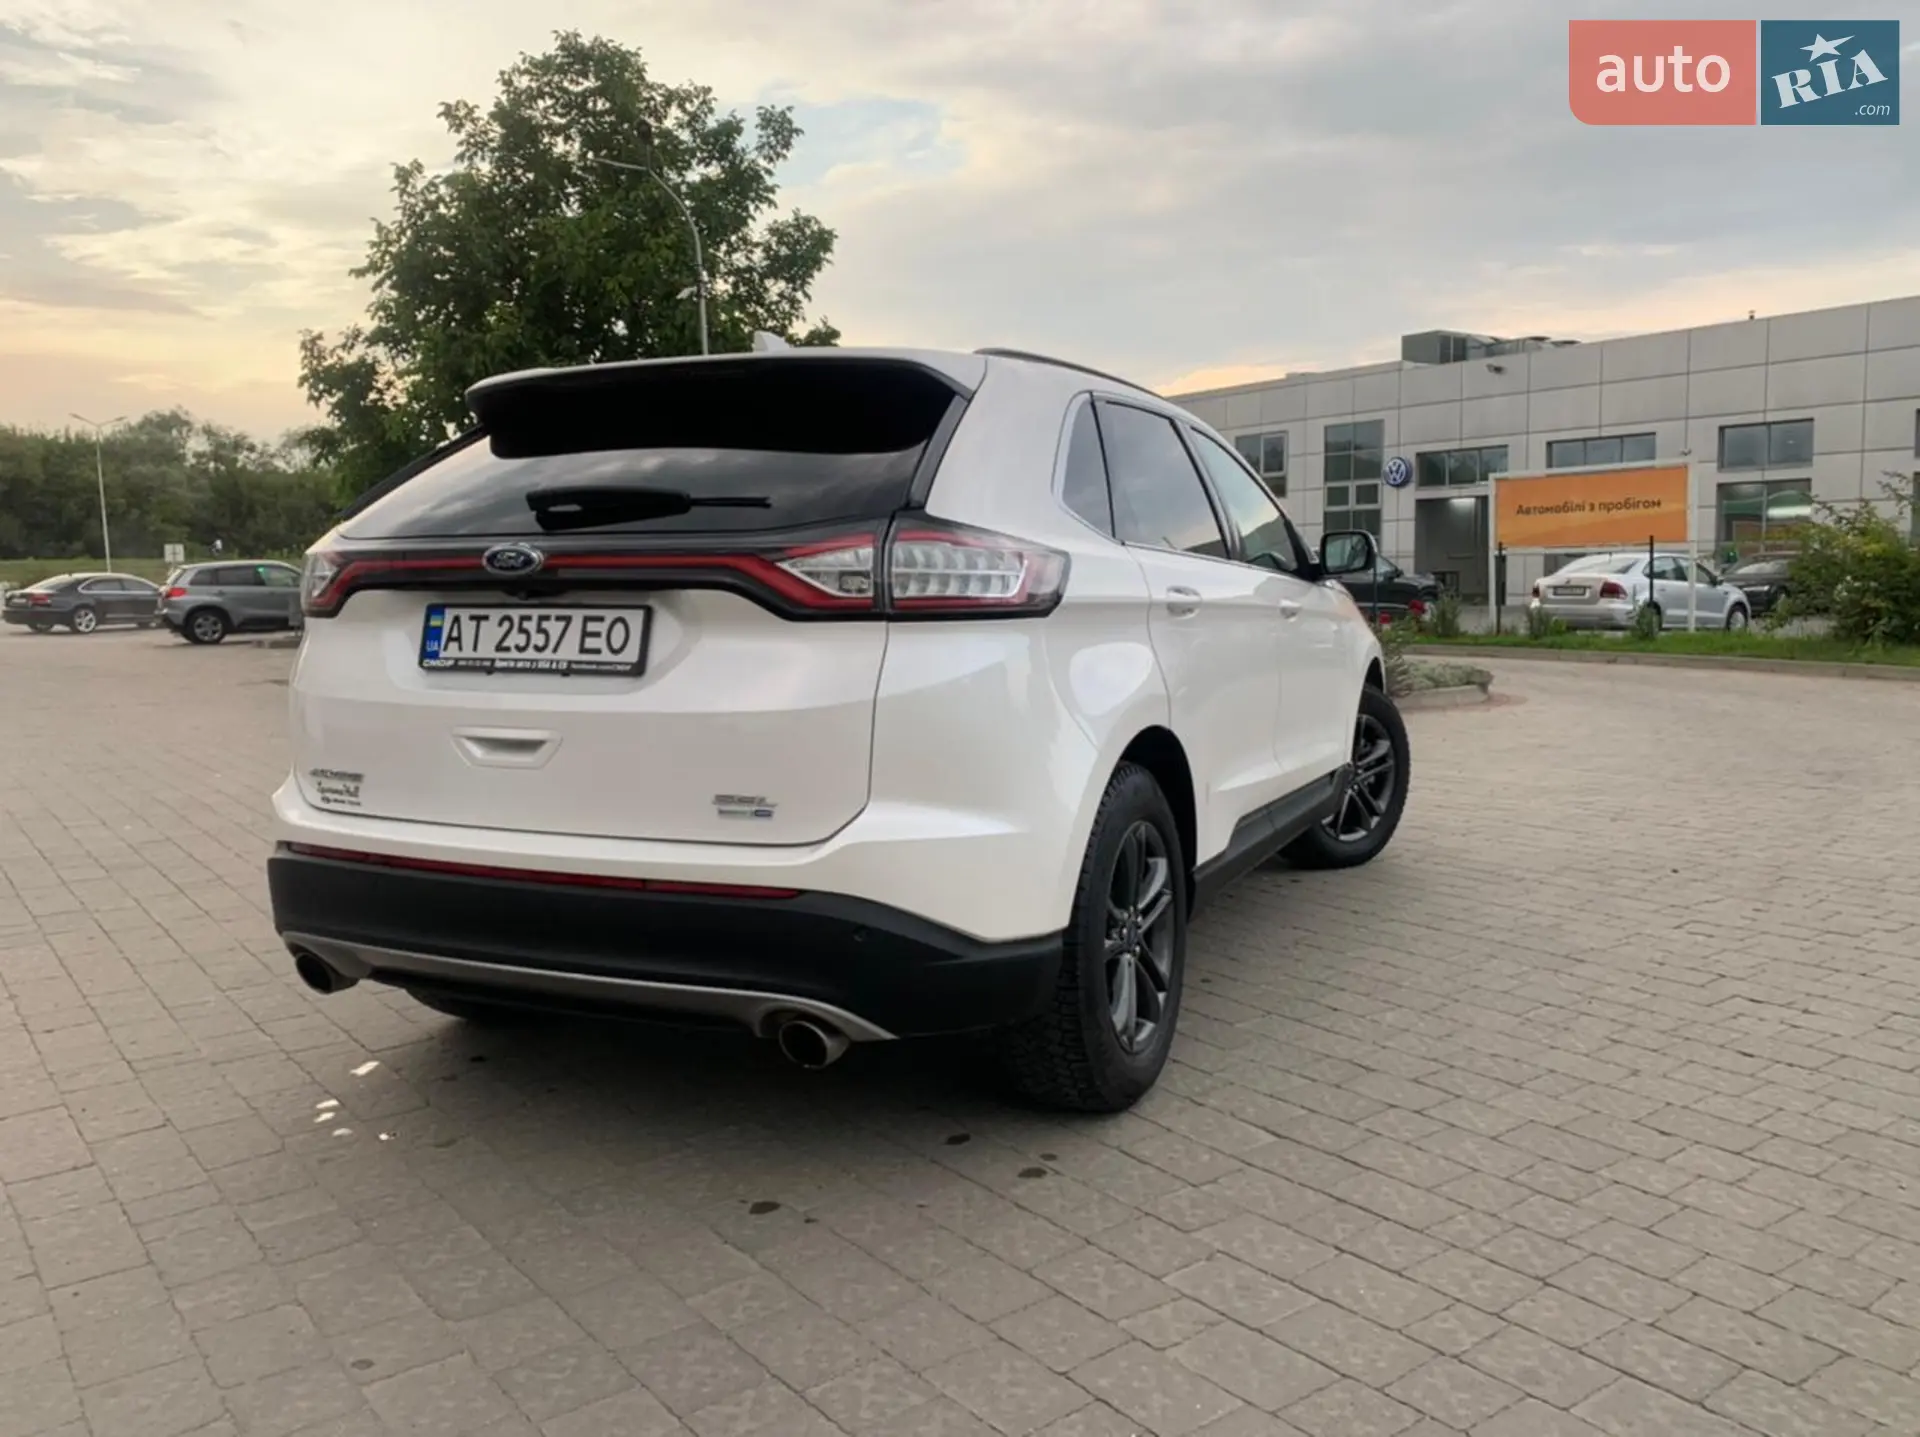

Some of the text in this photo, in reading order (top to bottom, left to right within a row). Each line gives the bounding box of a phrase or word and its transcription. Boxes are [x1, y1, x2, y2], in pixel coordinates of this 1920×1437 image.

[1516, 497, 1662, 516] Автомобілі з пробігом
[442, 613, 631, 656] AT 2557 EO
[426, 639, 439, 652] UA
